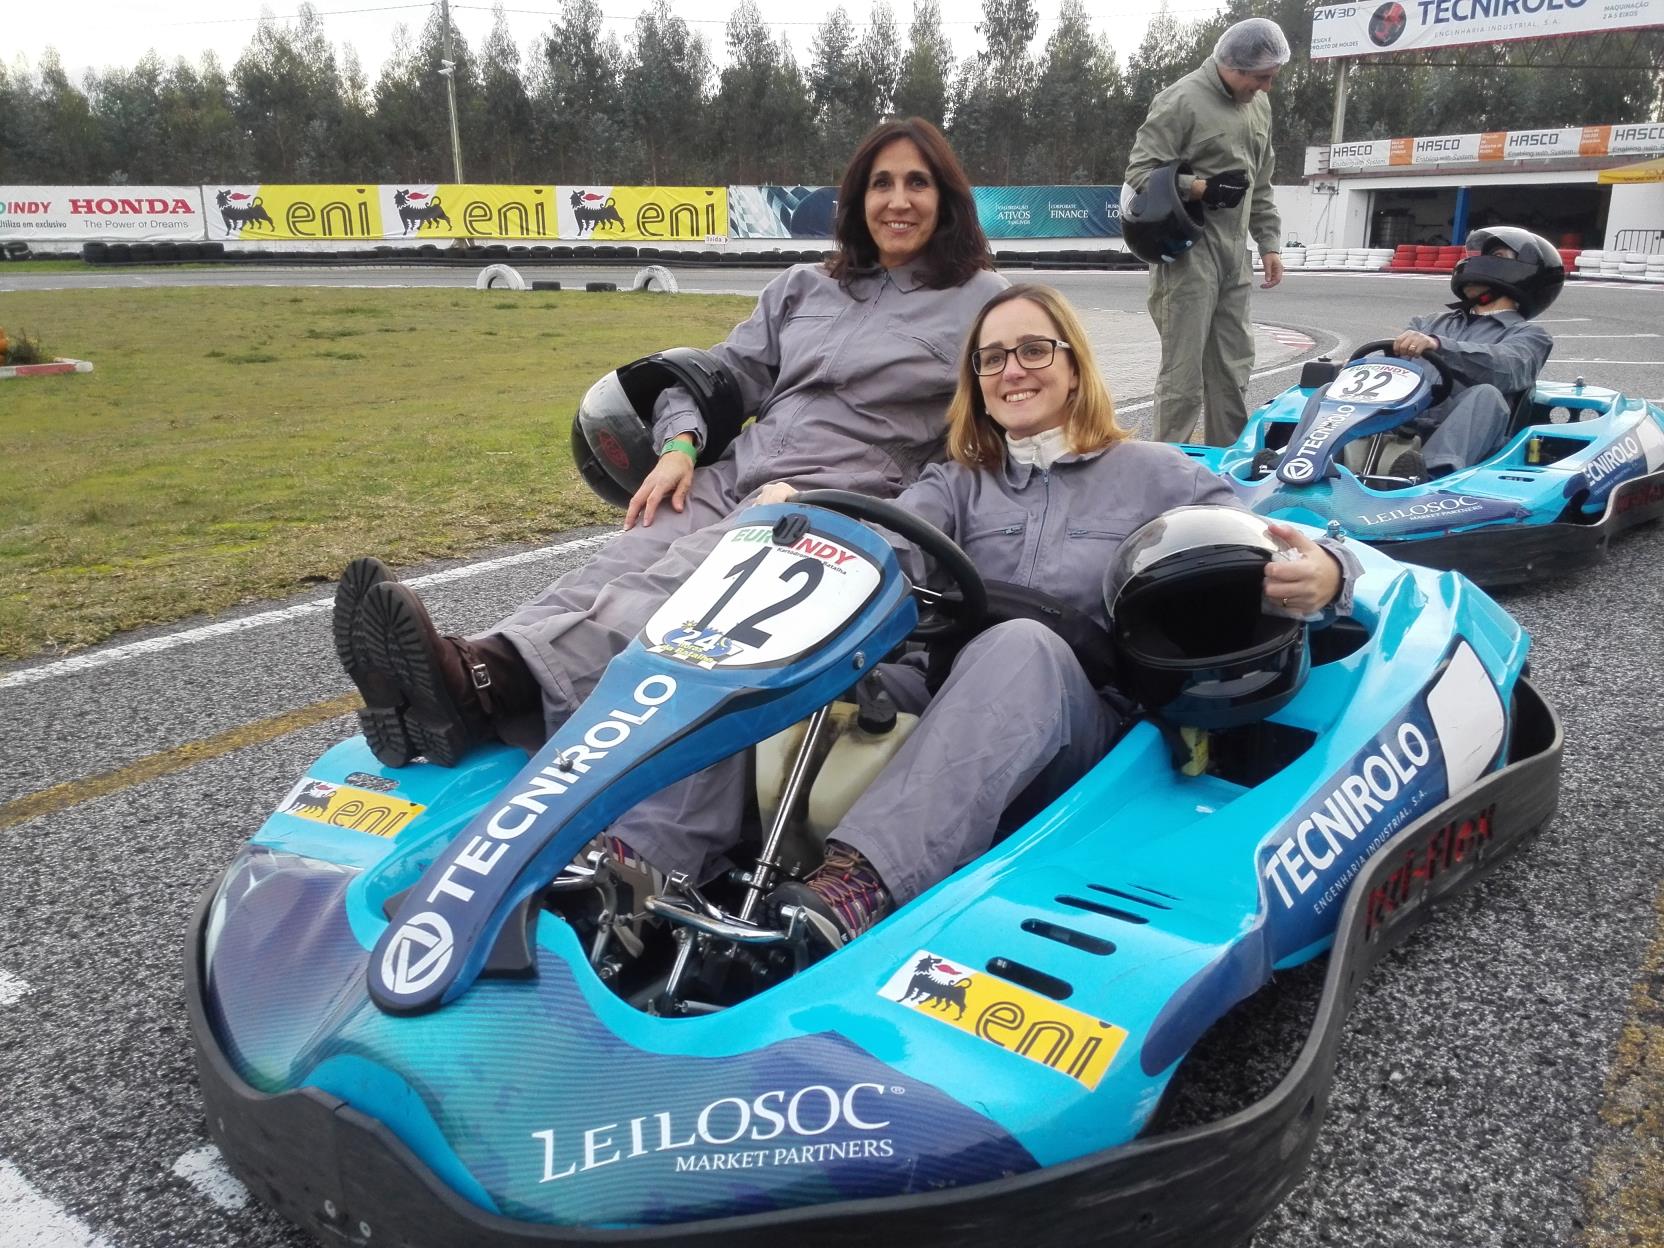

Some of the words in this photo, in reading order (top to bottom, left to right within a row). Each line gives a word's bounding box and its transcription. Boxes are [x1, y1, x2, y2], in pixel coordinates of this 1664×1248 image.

[1333, 145, 1373, 157] HASCO
[1416, 139, 1460, 152] HASCO
[1509, 133, 1559, 146] HASCO
[69, 199, 195, 214] HONDA
[286, 188, 370, 236] eni
[463, 189, 546, 236] eni
[636, 190, 715, 236] eni
[998, 210, 1030, 220] ATIVOS
[1051, 209, 1089, 218] FINANCE
[1107, 209, 1120, 218] LO
[84, 220, 102, 228] The
[105, 220, 135, 228] Power
[139, 220, 147, 228] of
[151, 220, 188, 228] Dreams
[1342, 369, 1393, 397] 32
[1584, 436, 1638, 487] CNIROLO
[1357, 495, 1480, 525] LEILOSOC
[731, 528, 857, 565] EURINDY
[692, 546, 825, 648] 12
[427, 674, 677, 903] TECNIROLO
[328, 800, 417, 836] eni
[1265, 722, 1430, 909] TECNIROLO
[1313, 855, 1366, 915] ENGENHARIA
[975, 1001, 1112, 1079] eni
[675, 1150, 768, 1172] MARKET
[774, 1139, 894, 1166] PARTNERS
